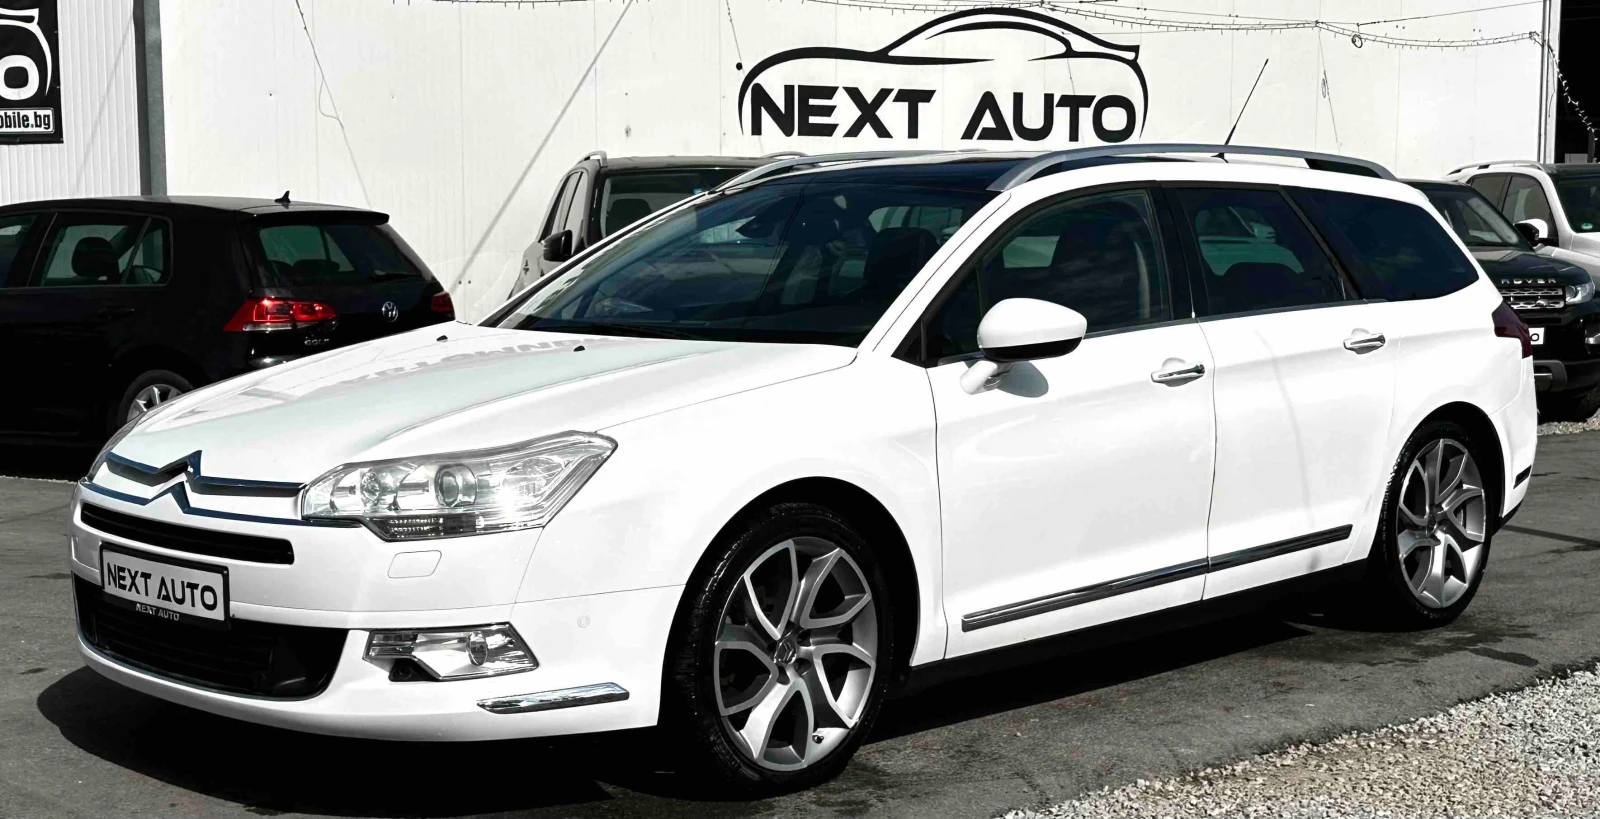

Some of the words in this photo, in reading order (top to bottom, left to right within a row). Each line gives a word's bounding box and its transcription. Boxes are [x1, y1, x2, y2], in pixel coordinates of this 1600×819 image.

[751, 82, 937, 139] NEXT
[960, 90, 1137, 143] AUTO
[107, 562, 152, 597] NEXT
[156, 576, 218, 611] AUTO
[135, 602, 157, 616] NEXT
[157, 608, 180, 621] AUTO
